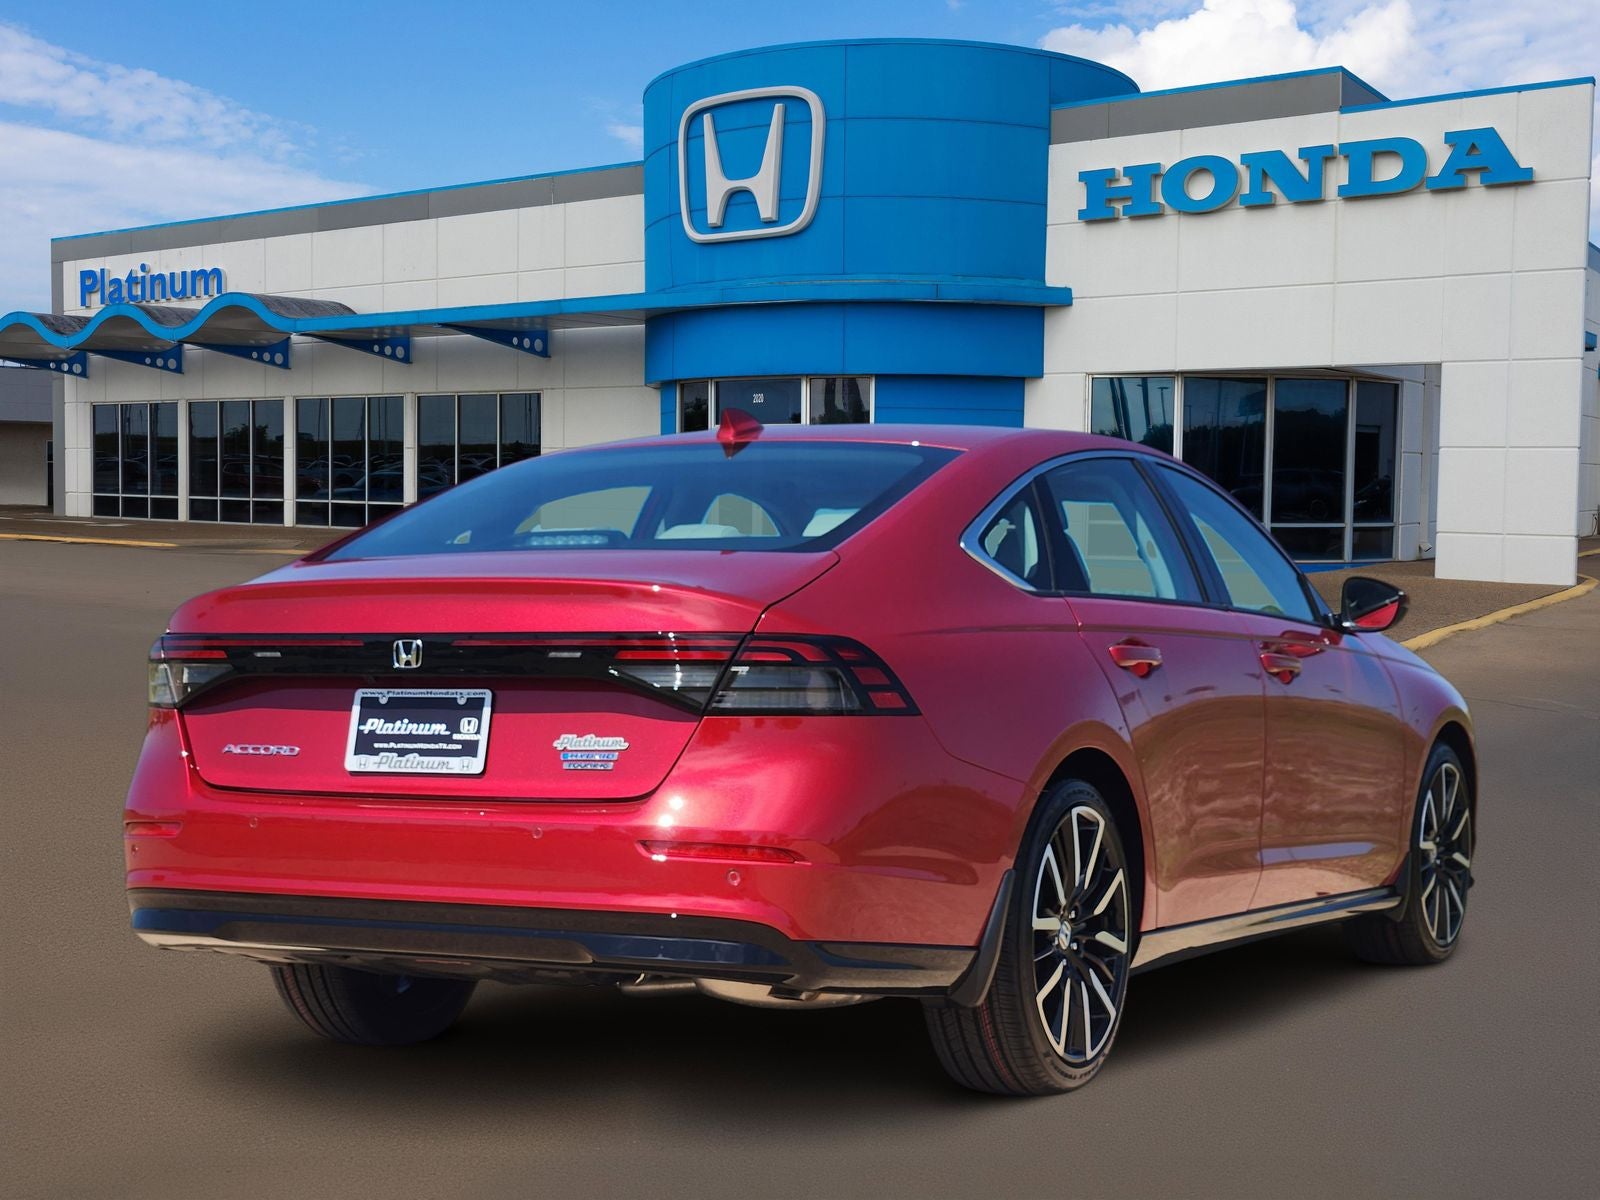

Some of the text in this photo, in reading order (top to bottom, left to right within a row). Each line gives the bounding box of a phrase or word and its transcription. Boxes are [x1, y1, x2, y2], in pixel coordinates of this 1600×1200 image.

[1078, 127, 1534, 222] HONDA
[79, 263, 227, 307] Platinum
[359, 718, 450, 735] Platinum
[222, 744, 300, 756] ACCORD
[554, 734, 629, 750] Platinum
[373, 754, 455, 771] Platinum
